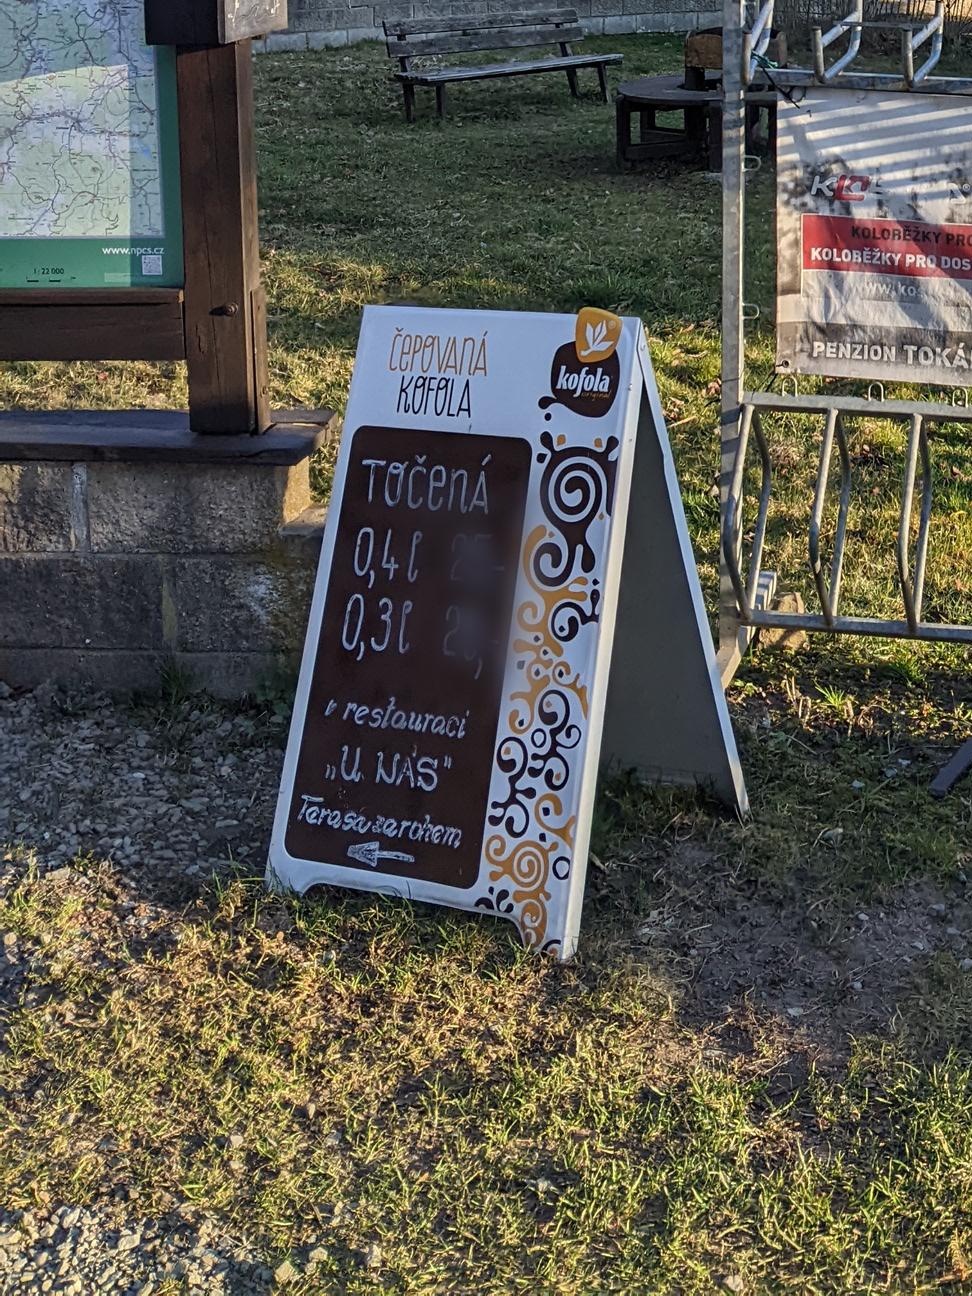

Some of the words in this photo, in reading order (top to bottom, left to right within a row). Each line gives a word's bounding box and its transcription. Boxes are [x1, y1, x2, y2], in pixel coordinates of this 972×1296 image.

[852, 225, 941, 244] KOLOBĚŽKY
[102, 247, 165, 256] www.npcs.cz
[811, 246, 902, 266] KOLOBĚŽKY
[905, 254, 937, 269] PRO
[812, 341, 896, 362] PENZION
[555, 365, 610, 398] kofola
[396, 375, 472, 419] KOFOLA
